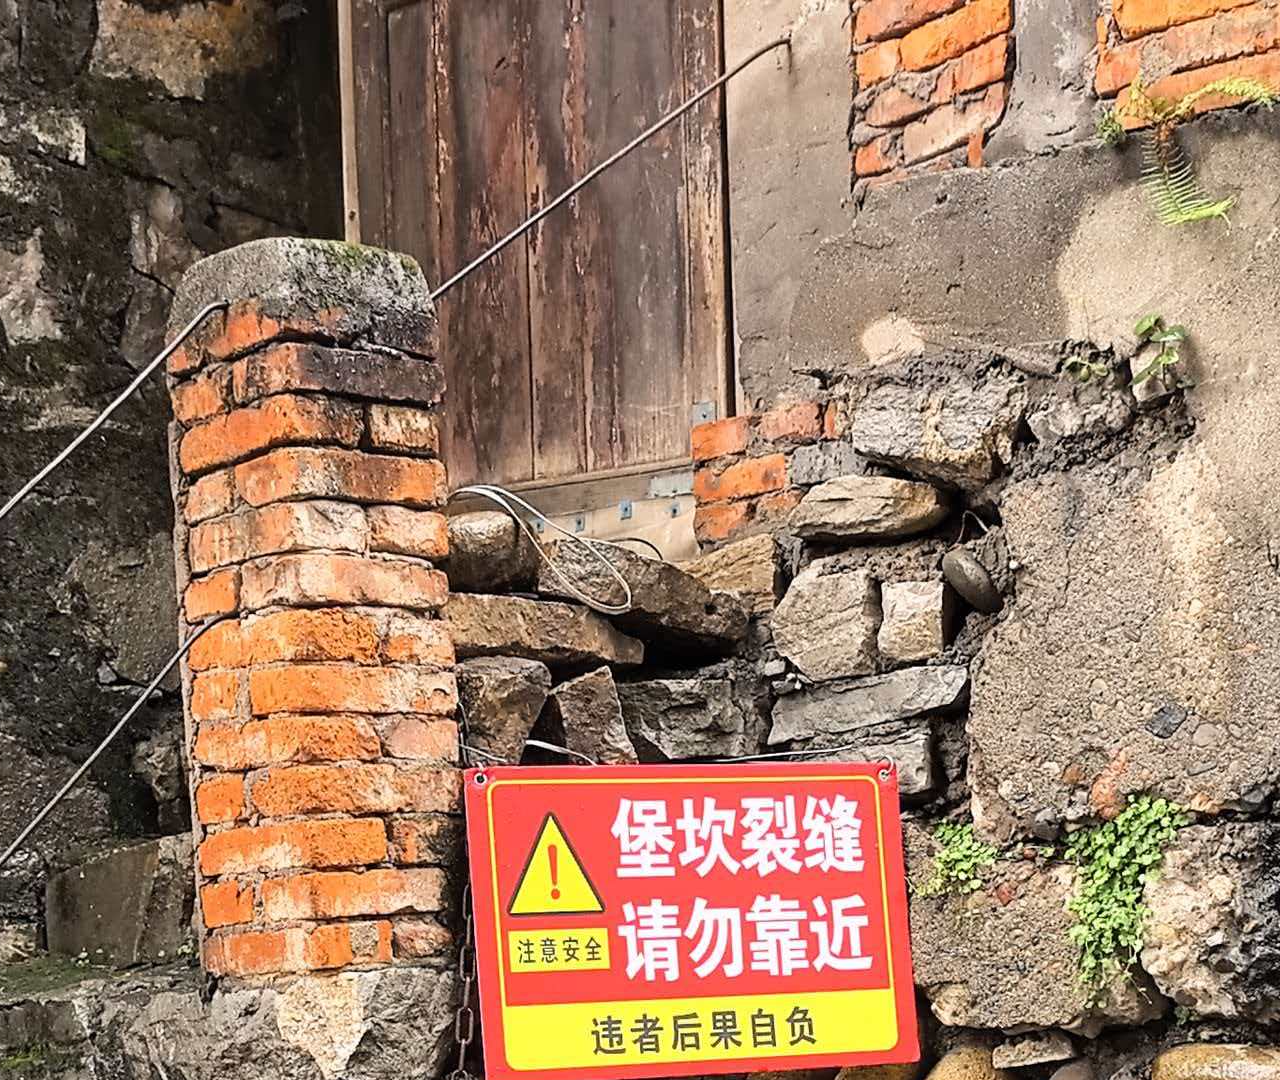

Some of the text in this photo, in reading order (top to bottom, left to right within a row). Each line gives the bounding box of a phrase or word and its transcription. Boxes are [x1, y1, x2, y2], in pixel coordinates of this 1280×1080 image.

[611, 794, 865, 878] 堡坎裂缝
[517, 936, 603, 965] 注意安全
[617, 894, 873, 982] 请勿靠近
[590, 1006, 817, 1056] 违者后果自负
